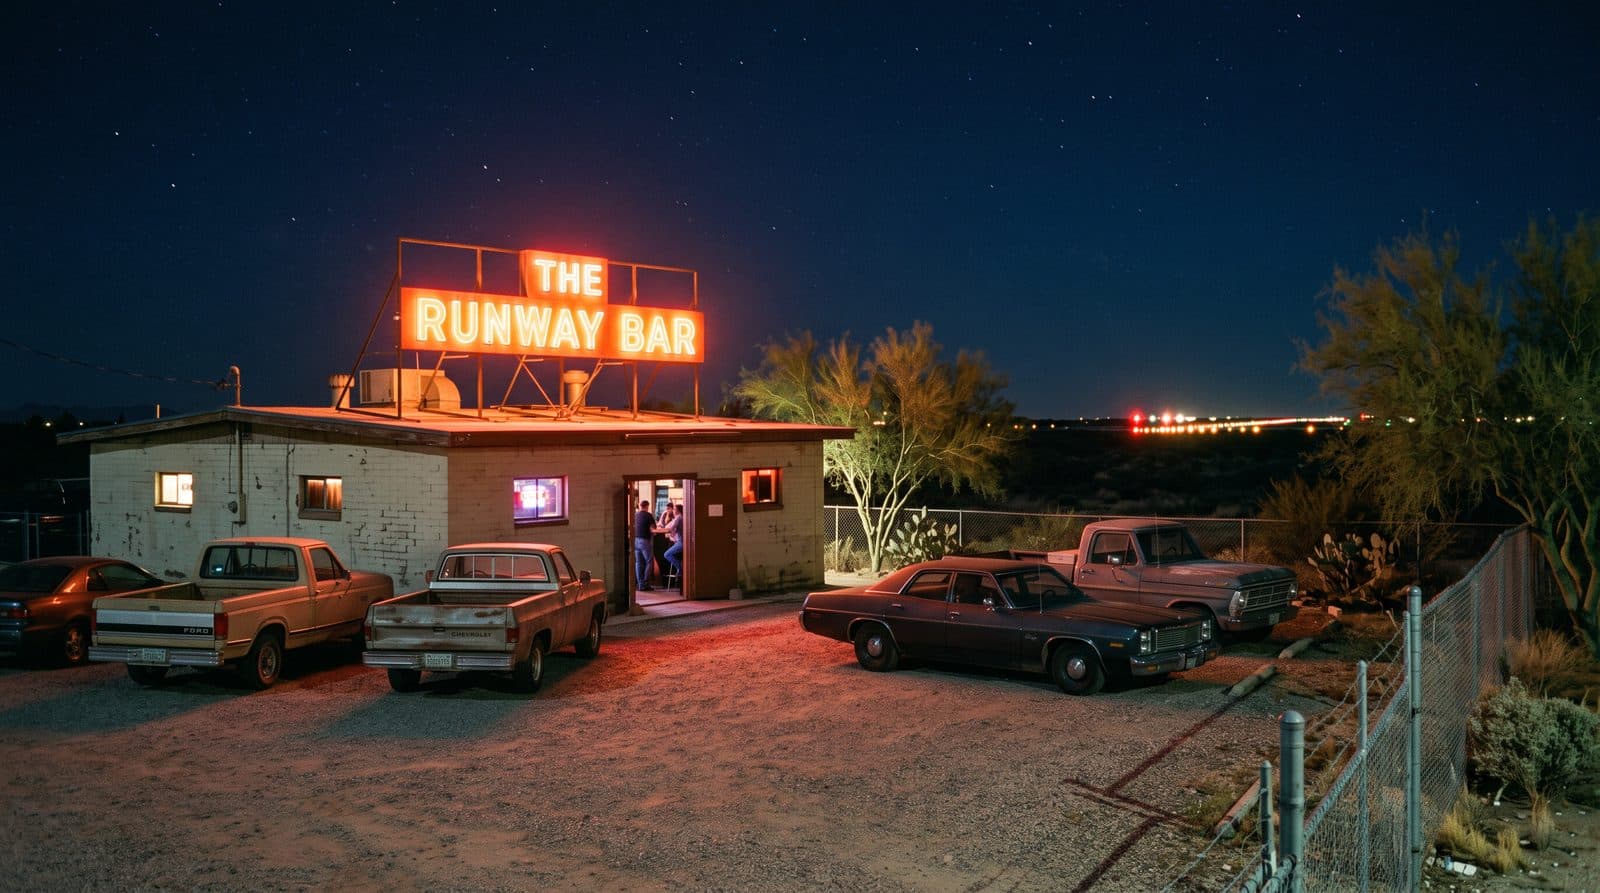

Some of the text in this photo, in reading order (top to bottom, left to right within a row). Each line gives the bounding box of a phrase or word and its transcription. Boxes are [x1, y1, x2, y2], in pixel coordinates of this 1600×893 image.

[534, 259, 603, 297] THE
[416, 297, 697, 356] RUNWAY BAR
